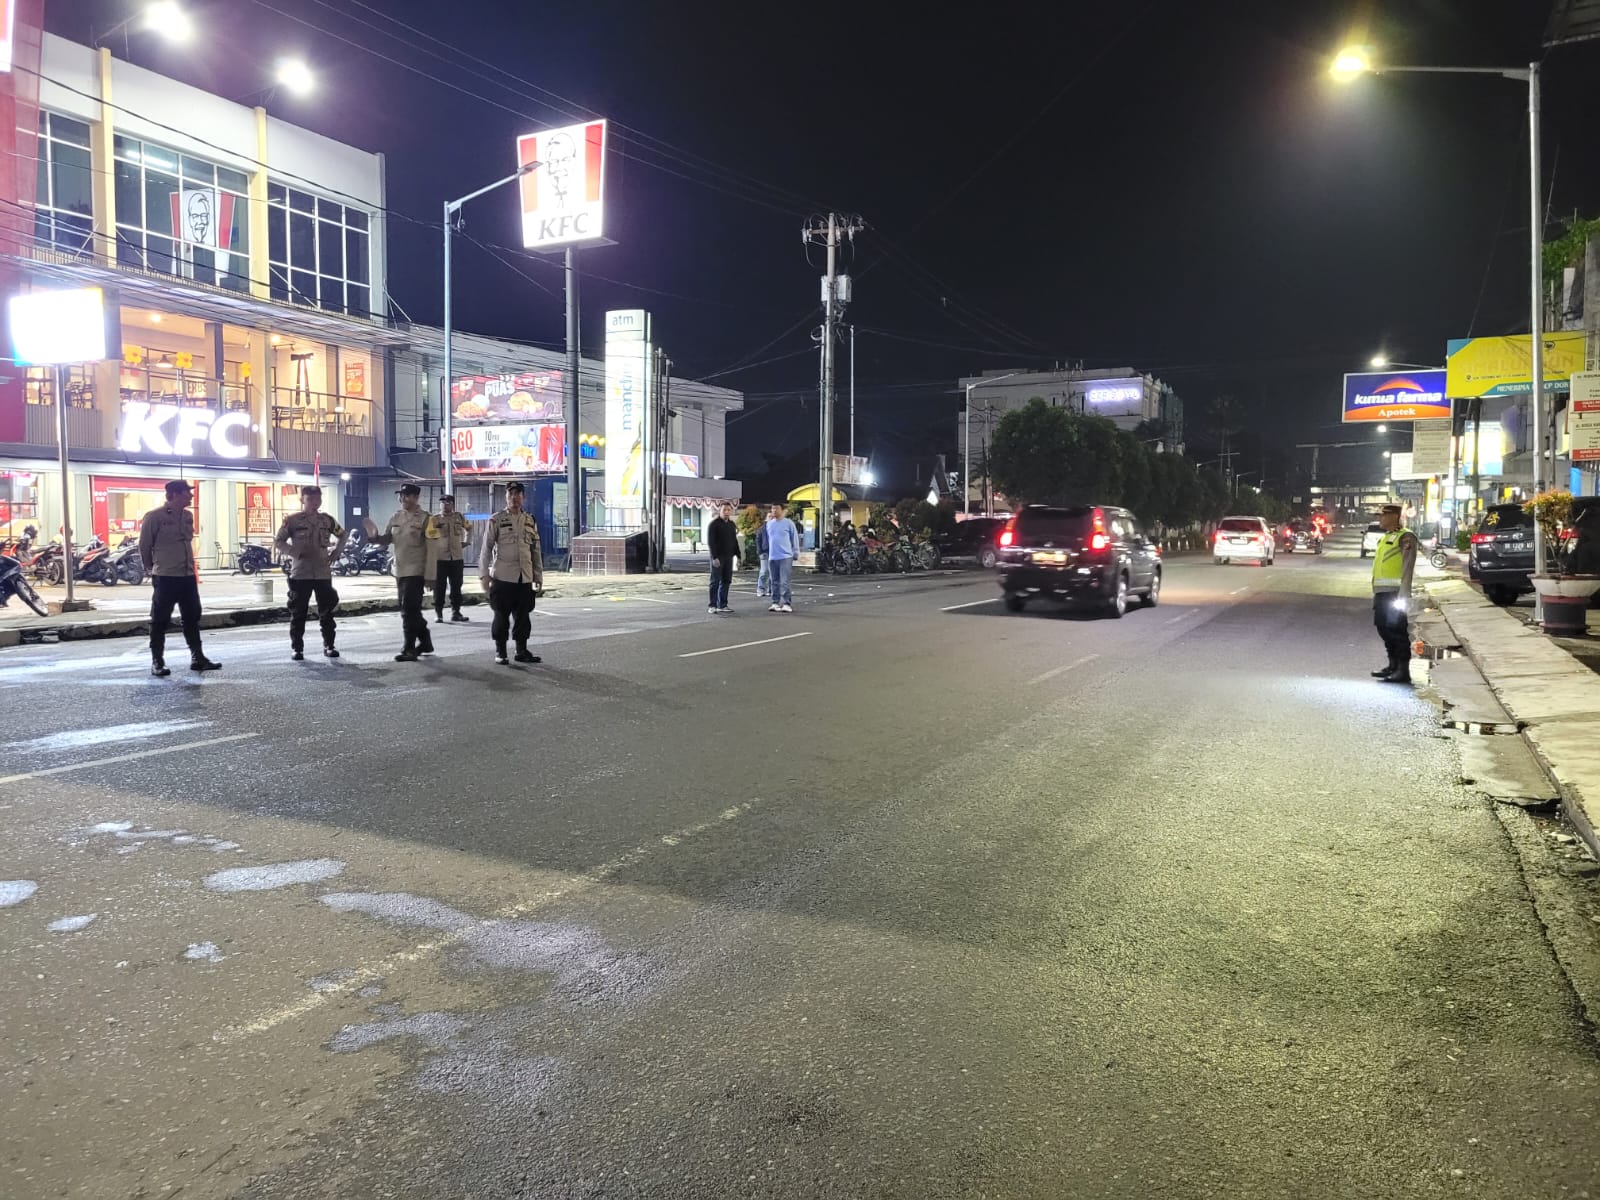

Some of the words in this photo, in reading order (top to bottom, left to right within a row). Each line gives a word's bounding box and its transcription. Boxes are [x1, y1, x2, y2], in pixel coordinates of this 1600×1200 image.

[538, 211, 589, 240] KFC
[612, 314, 634, 326] atm
[620, 362, 632, 431] mandiri
[1354, 394, 1395, 404] kimia
[1397, 391, 1442, 403] farma
[1378, 408, 1416, 418] Apotek
[119, 400, 252, 459] KFC
